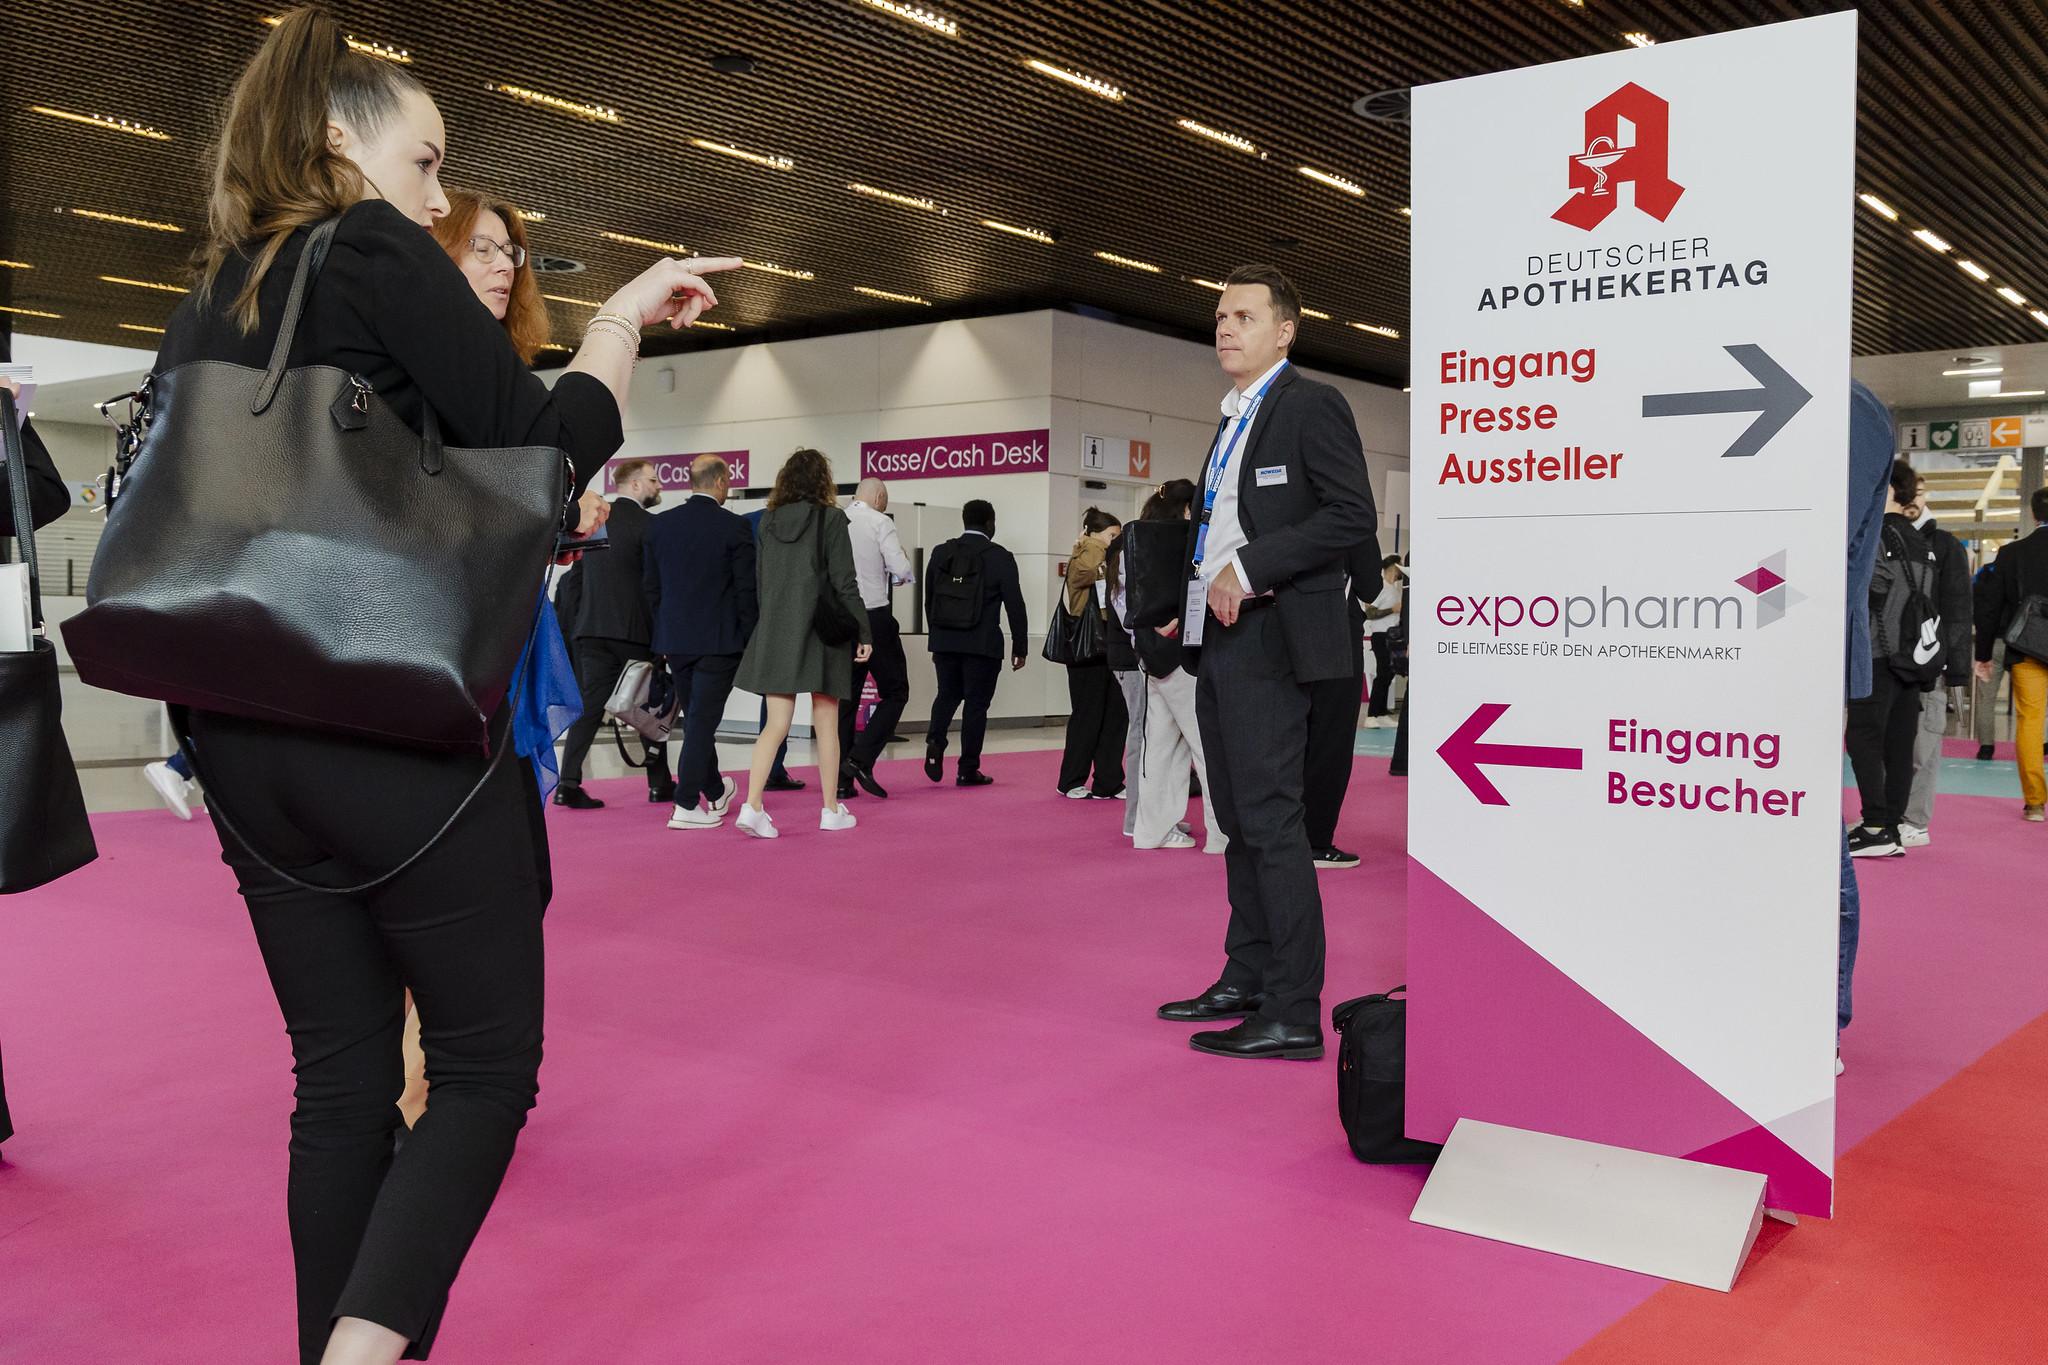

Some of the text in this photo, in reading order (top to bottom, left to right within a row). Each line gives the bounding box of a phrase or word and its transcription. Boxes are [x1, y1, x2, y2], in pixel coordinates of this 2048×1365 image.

[1527, 237, 1709, 277] DEUTSCHER
[1477, 259, 1768, 312] APOTHEKERTAG
[1440, 348, 1596, 389] Eingang
[1440, 402, 1558, 435] Presse
[866, 439, 1044, 473] Kasse/Cash Desk
[1438, 446, 1624, 486] Aussteller
[1436, 585, 1743, 638] expopharm
[1437, 641, 1742, 660] DIE LEITMESSE FÜR DEN APOTHEKENMARKT
[1608, 718, 1781, 769] Eingang
[1607, 771, 1807, 817] Besucher
